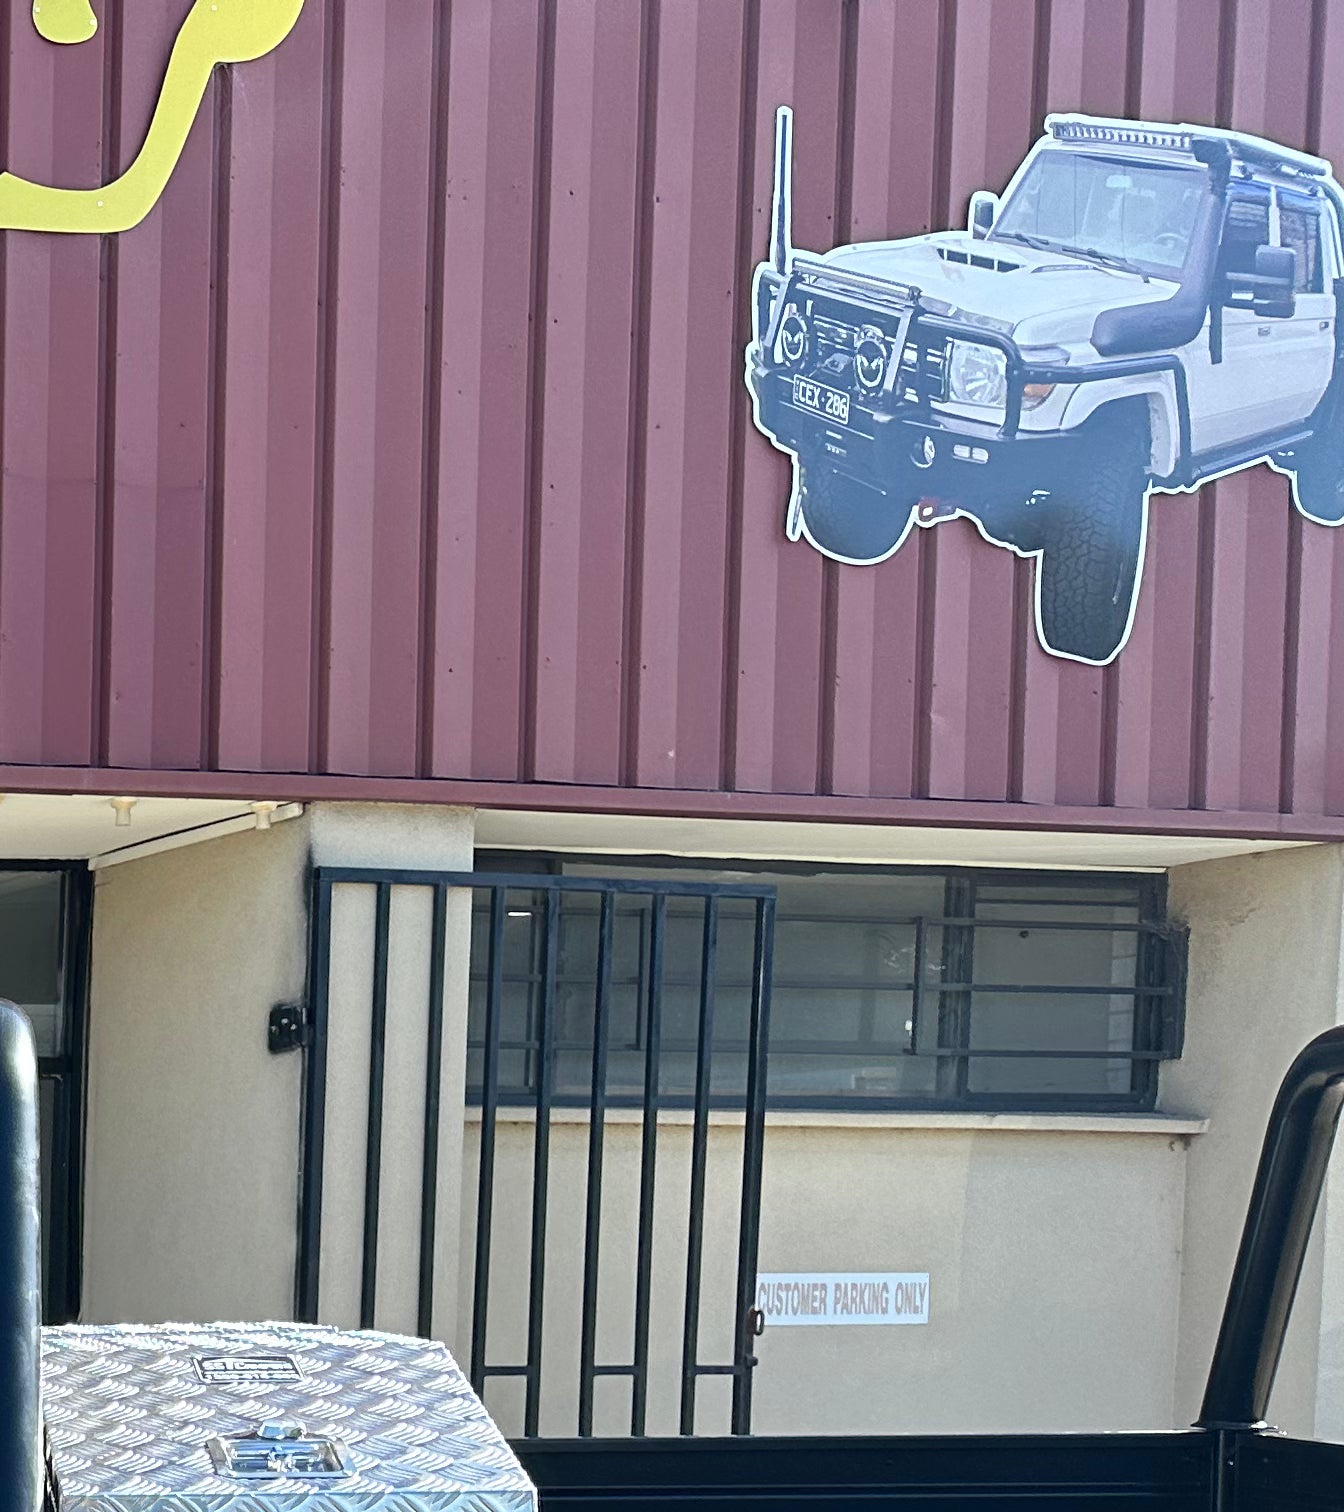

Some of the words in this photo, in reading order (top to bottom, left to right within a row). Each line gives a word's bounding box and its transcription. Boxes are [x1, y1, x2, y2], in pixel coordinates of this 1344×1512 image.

[757, 1282, 828, 1316] CUSTOMER
[833, 1282, 890, 1316] PARKING
[895, 1281, 928, 1316] ONLY
